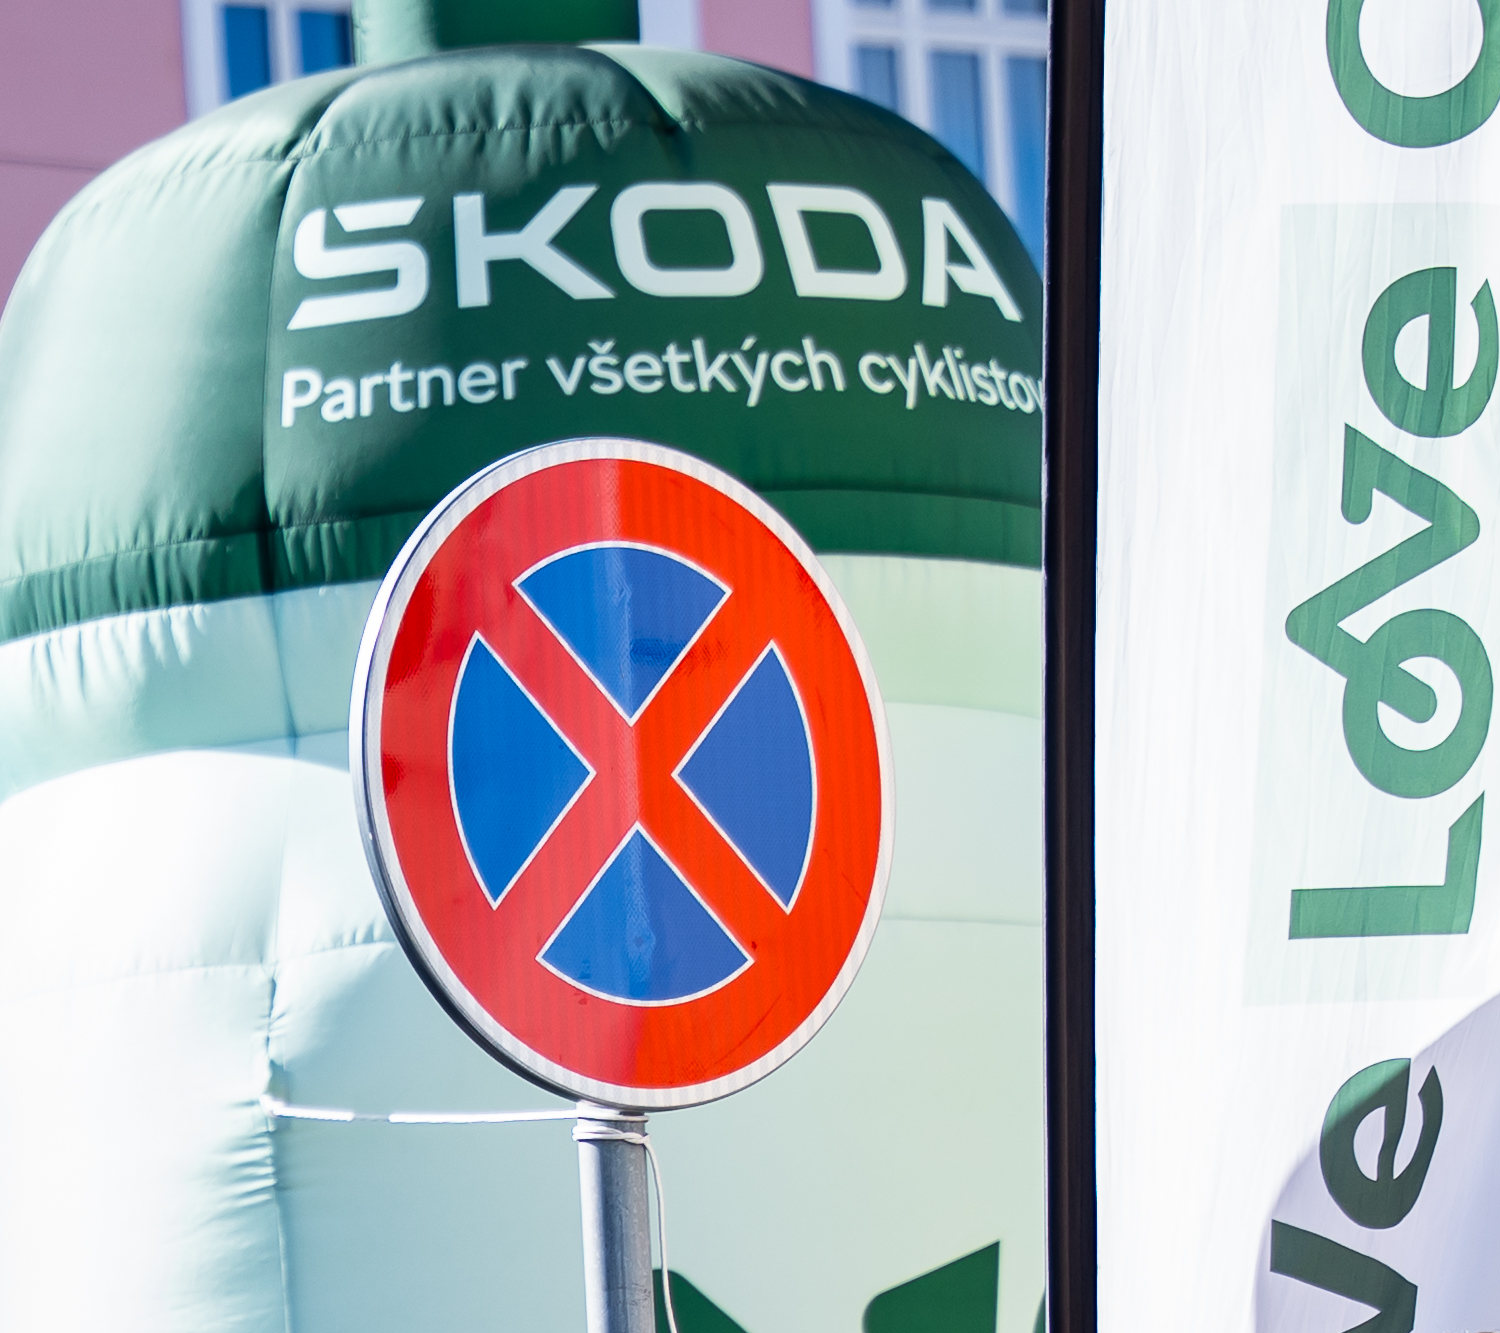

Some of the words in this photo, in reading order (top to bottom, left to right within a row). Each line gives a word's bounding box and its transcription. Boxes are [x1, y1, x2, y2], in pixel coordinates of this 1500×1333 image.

[280, 354, 527, 428] Partner
[546, 336, 845, 408] všetkých
[1284, 266, 1499, 940] Love
